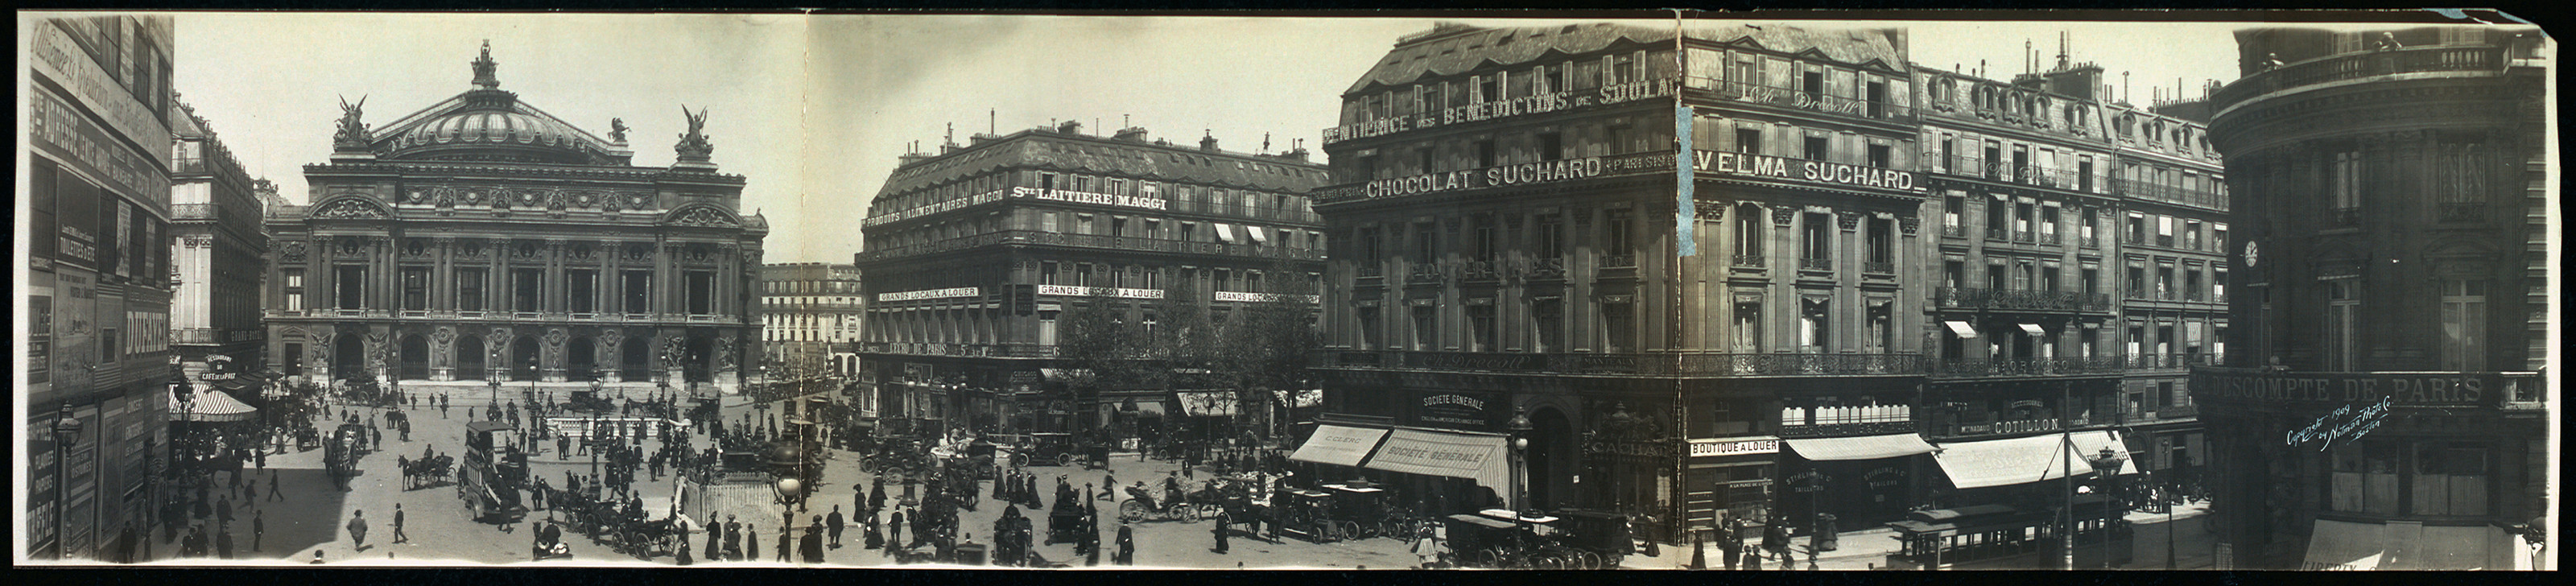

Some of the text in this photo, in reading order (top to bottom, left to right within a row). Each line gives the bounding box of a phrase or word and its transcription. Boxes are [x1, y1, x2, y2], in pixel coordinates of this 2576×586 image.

[45, 98, 78, 157] ADRESSE
[1366, 170, 1472, 198] CHOCOLAT
[1487, 156, 1602, 186] SUCHARD
[1696, 150, 1913, 192] VELMA SUCHARD
[866, 189, 1003, 228] PRODUITS ALIMENTAIRES MAGGI
[1036, 188, 1113, 205] LAITIERE
[1117, 194, 1166, 210] MAGGI
[881, 287, 976, 301] GRANDS LOCAUX A LOUER
[1042, 285, 1079, 295] GRANDS
[1123, 288, 1131, 296] A
[1133, 289, 1162, 299] LOUER
[1217, 291, 1247, 300] GRANDS
[126, 310, 167, 355] DUFAYEL
[914, 343, 923, 356] DE
[927, 343, 947, 357] PARIS
[1451, 353, 1531, 369] Drecoll
[2342, 378, 2378, 402] DE
[2392, 378, 2481, 402] PARIS
[1994, 418, 2059, 435] COTILLON
[1693, 444, 1739, 454] BOUTIQUE
[1748, 440, 1777, 452] LOUER
